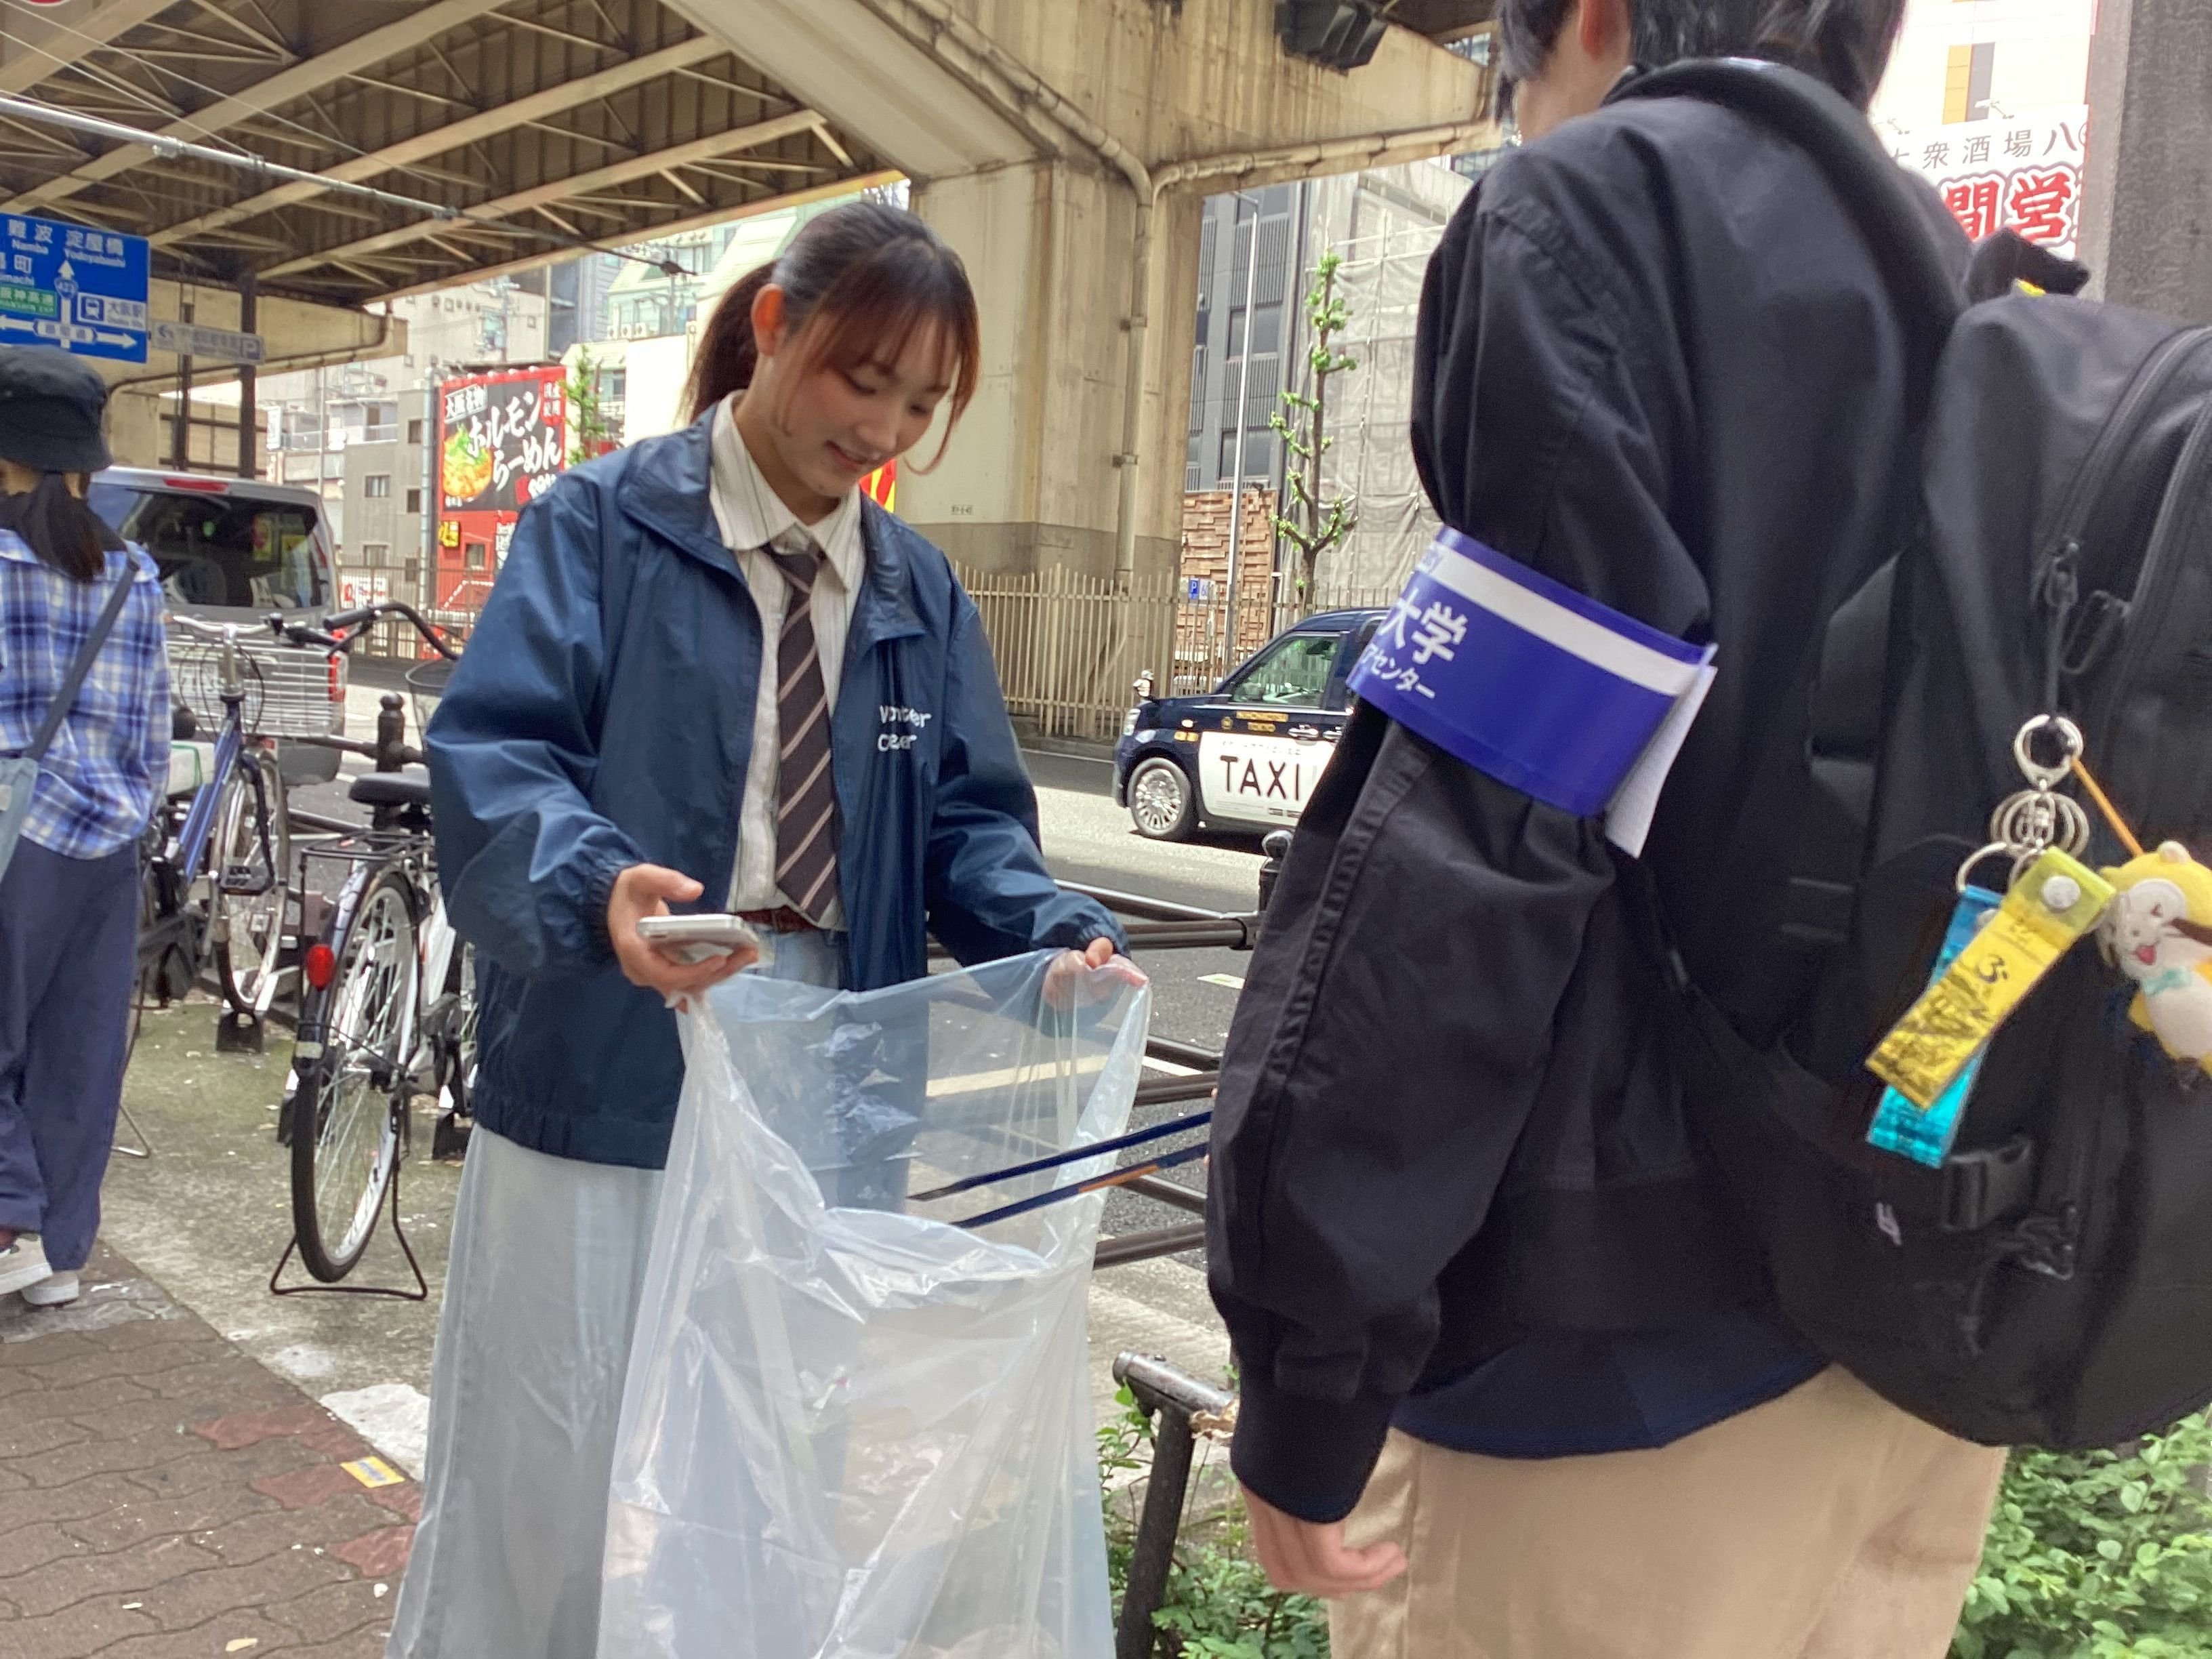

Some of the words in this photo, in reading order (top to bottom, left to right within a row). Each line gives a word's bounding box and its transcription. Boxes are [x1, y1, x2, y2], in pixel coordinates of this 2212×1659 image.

[467, 391, 541, 458] ホルモン
[493, 426, 562, 492] らーめん
[1378, 587, 1468, 664] 大学
[1220, 754, 1300, 801] TAXI
